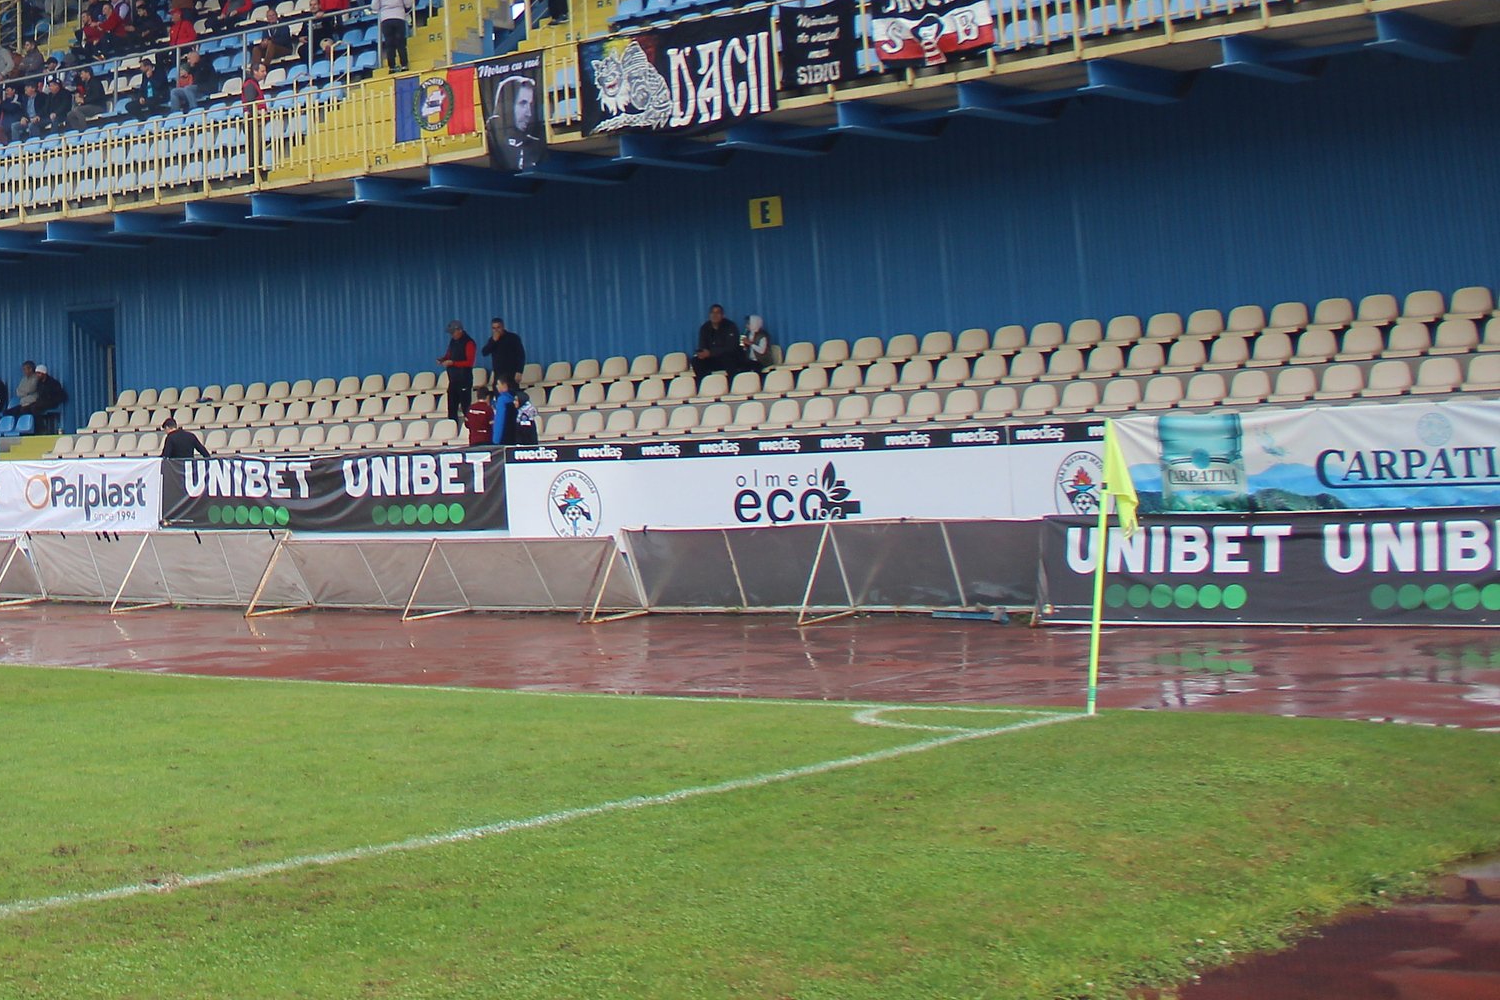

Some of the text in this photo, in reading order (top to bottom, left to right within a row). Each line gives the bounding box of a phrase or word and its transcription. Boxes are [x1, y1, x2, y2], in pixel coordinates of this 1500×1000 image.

[666, 31, 772, 128] DACII
[796, 60, 841, 86] SIBIU
[761, 202, 771, 225] E
[184, 452, 492, 498] UNIBET UNIBET
[735, 467, 818, 488] olmed
[1316, 446, 1500, 489] CARPATI
[50, 472, 146, 522] Palplast
[116, 511, 136, 522] 1994
[1066, 519, 1500, 575] UNIBET UNIB
